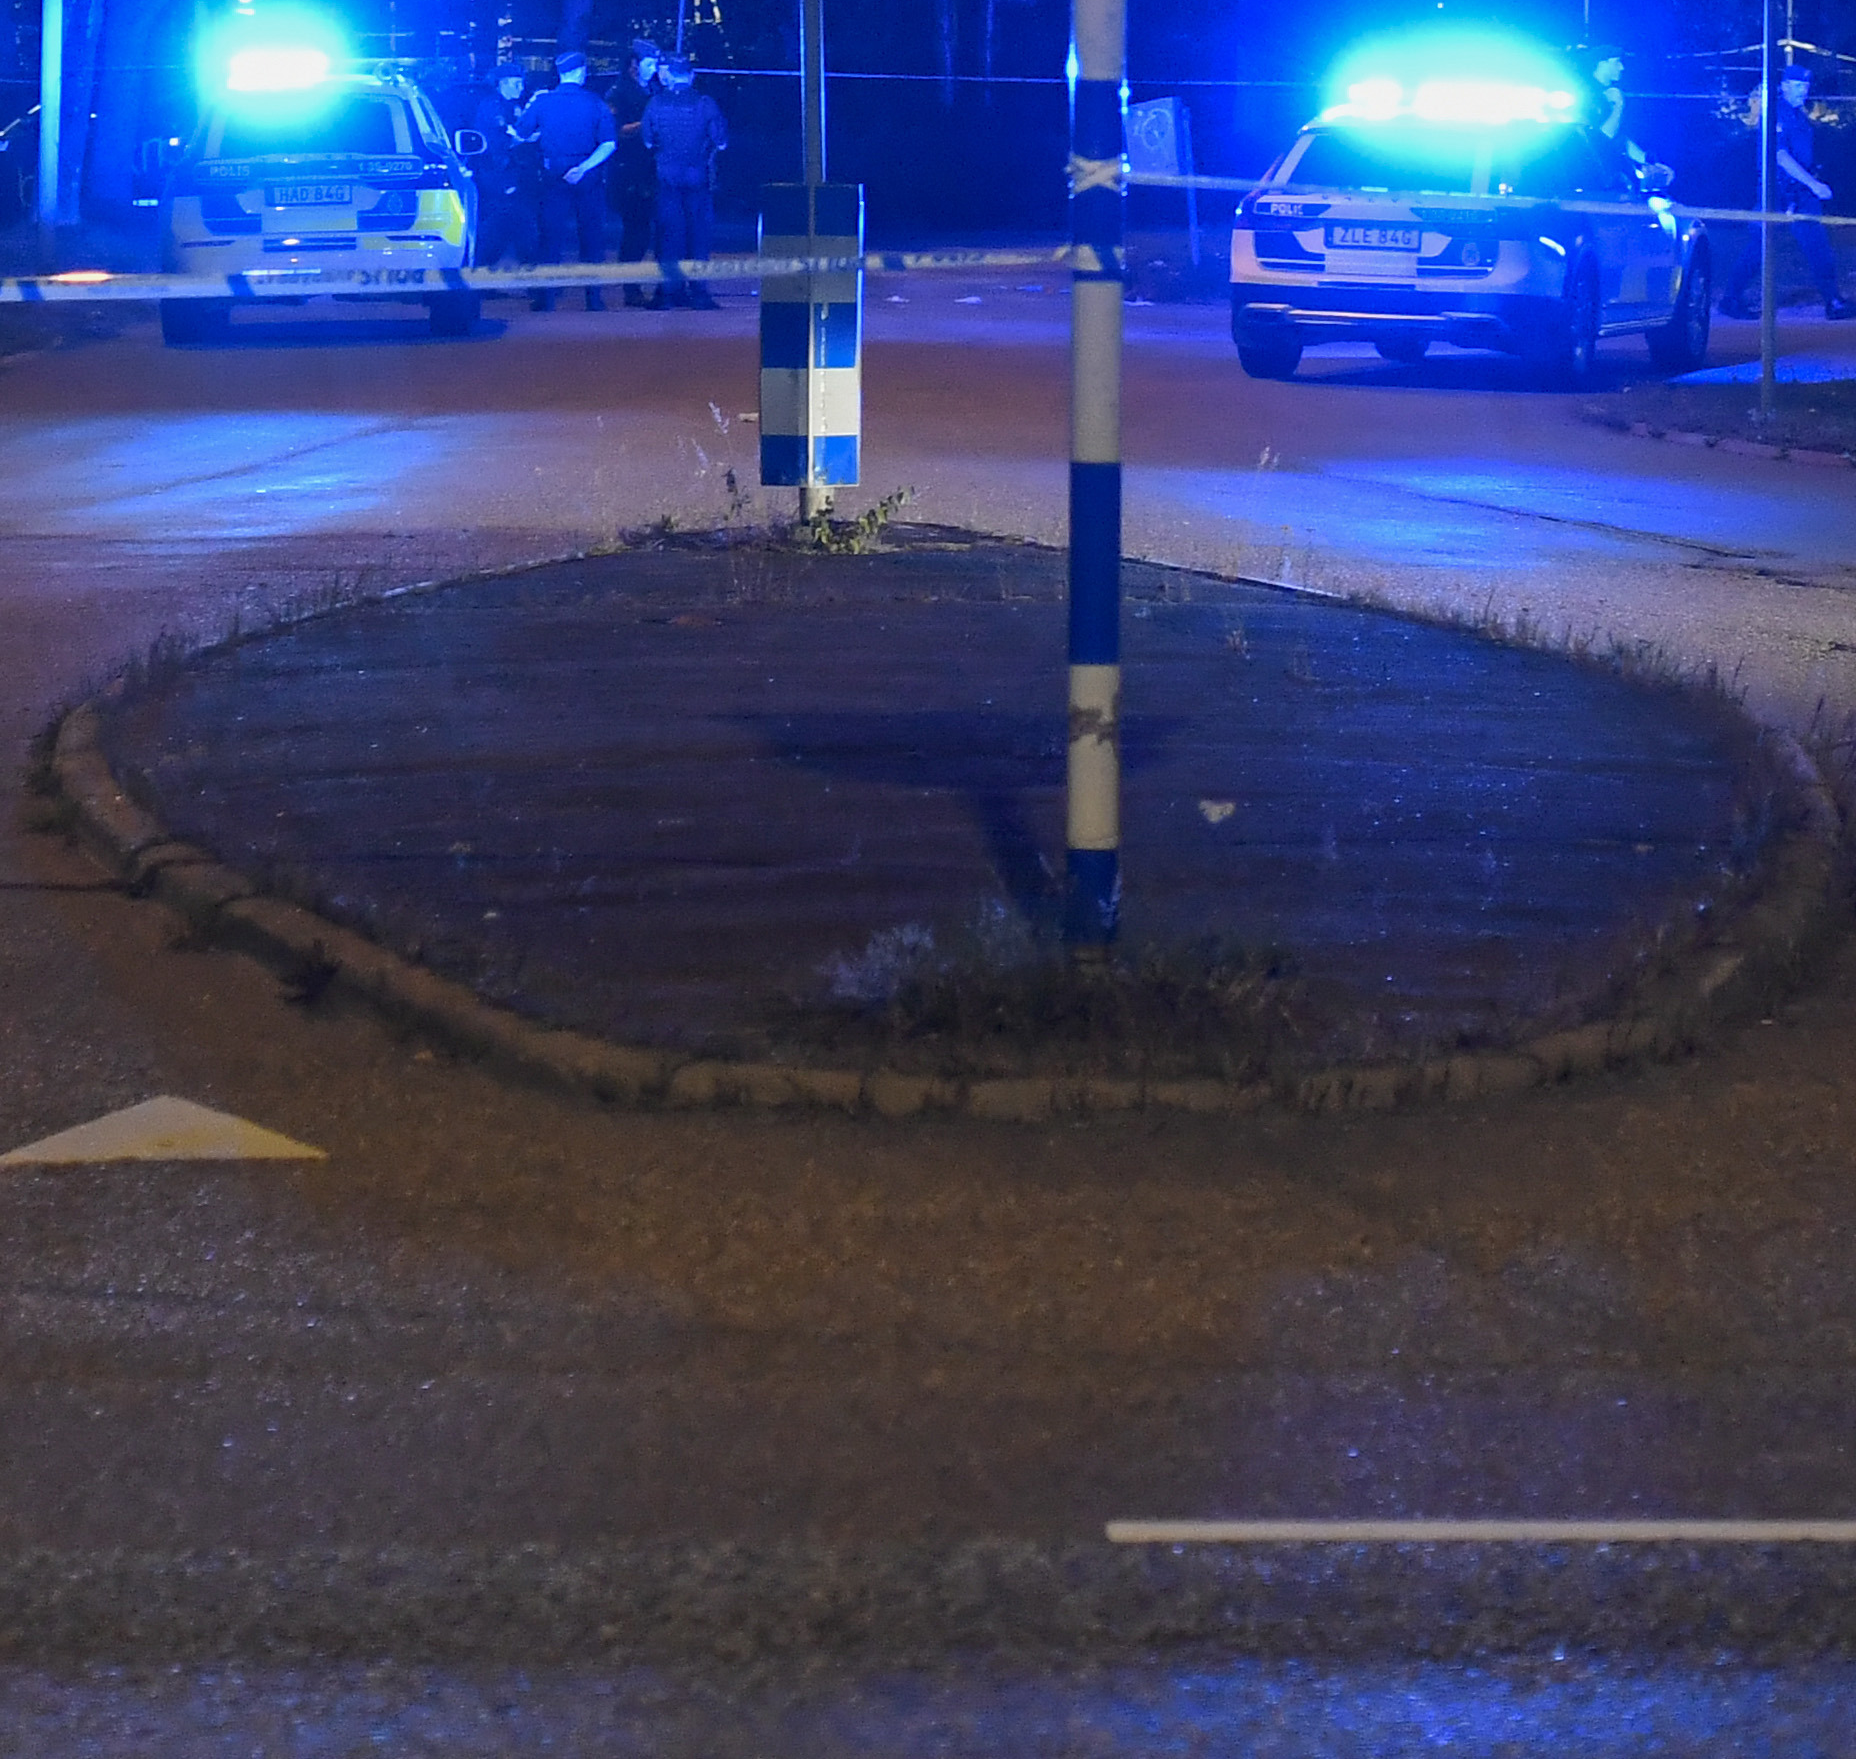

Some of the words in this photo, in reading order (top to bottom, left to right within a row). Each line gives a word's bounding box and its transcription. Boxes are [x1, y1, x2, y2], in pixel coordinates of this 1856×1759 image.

[210, 165, 250, 177] POLIS
[279, 188, 309, 201] HAD
[1339, 228, 1371, 244] ZLE
[1379, 230, 1411, 245] 84G
